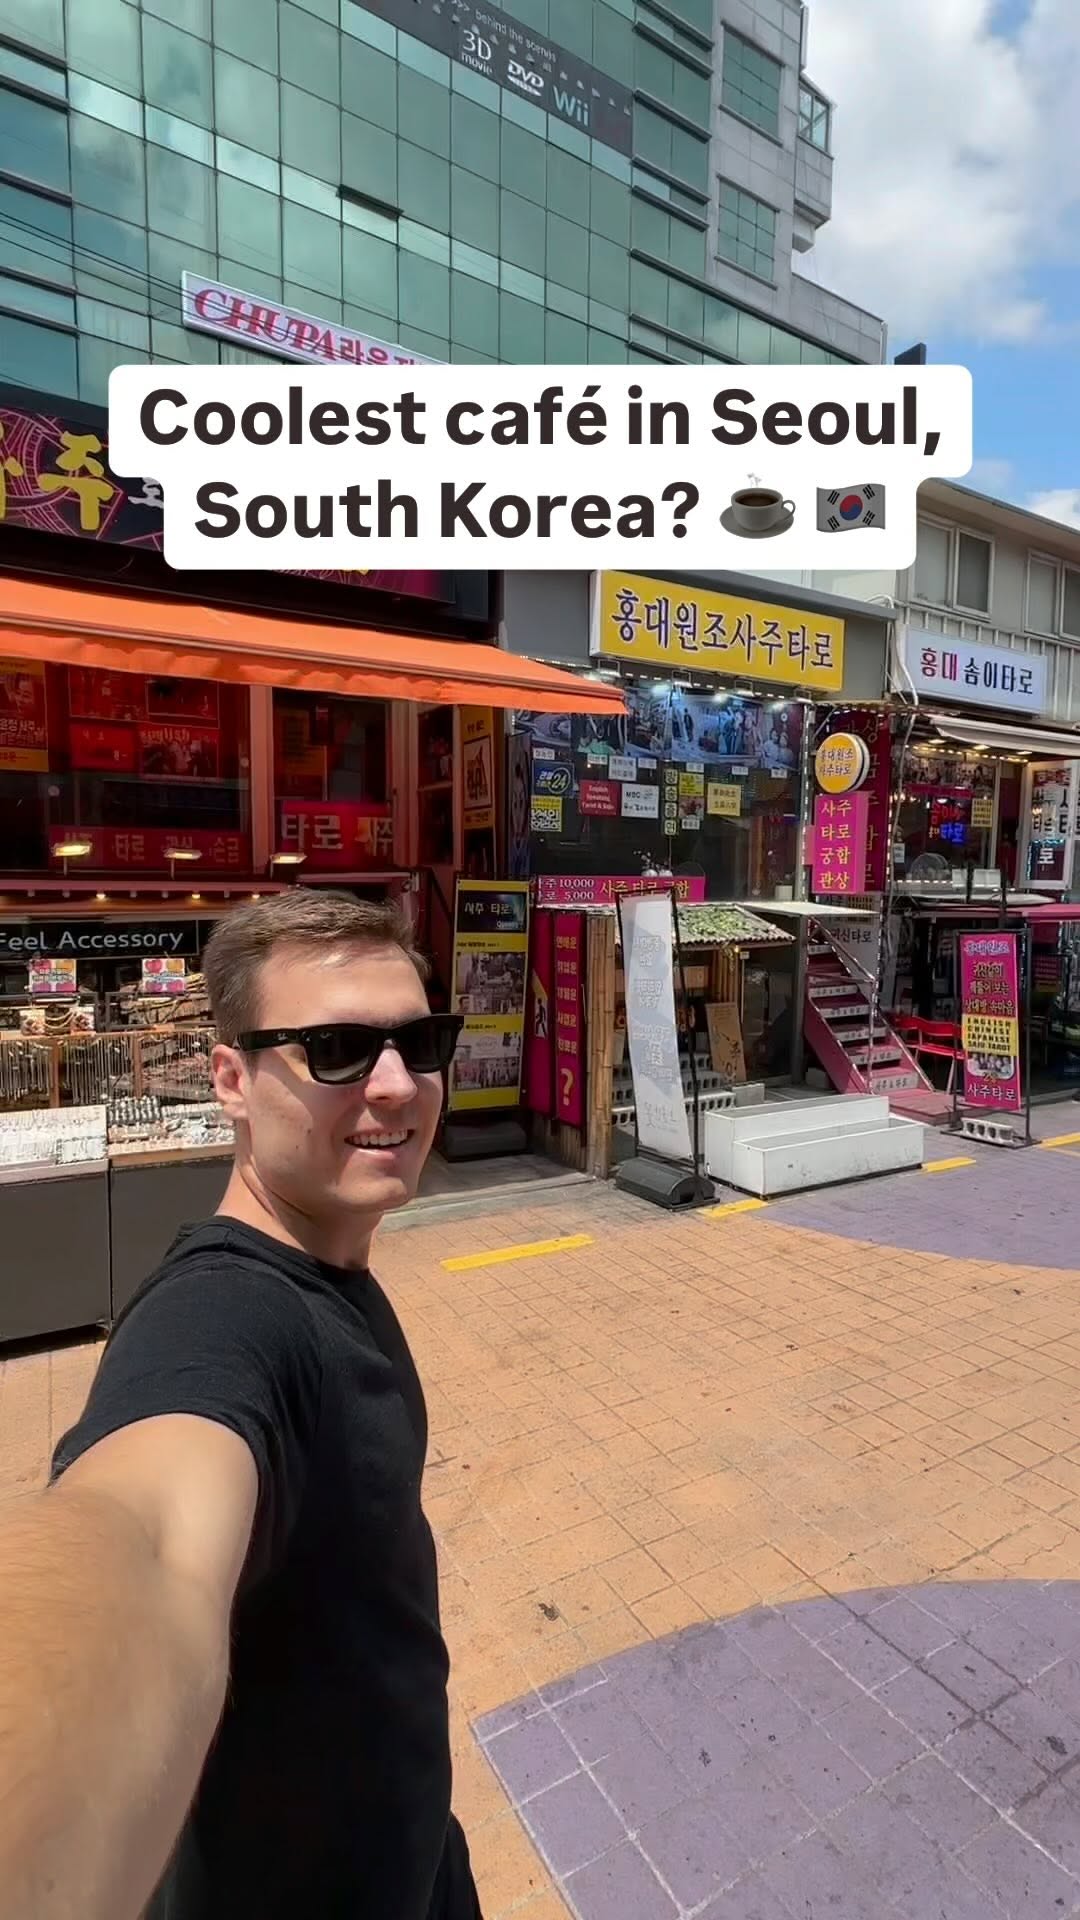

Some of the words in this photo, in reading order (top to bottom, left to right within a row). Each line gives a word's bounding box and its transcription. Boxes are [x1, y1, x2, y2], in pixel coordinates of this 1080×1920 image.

[475, 9, 507, 35] behind
[509, 27, 524, 45] the
[462, 29, 492, 61] 3D
[461, 51, 493, 76] movie
[507, 59, 545, 88] DVD
[552, 84, 589, 127] Wii
[194, 288, 337, 361] CHUPA
[611, 587, 834, 672] 홍대원조사주타로
[920, 647, 958, 681] 홍대
[964, 657, 1033, 695] 솜이타로
[551, 773, 568, 790] 24
[820, 800, 852, 818] 사주
[281, 813, 344, 851] 타로
[820, 824, 852, 841] 타로
[819, 847, 851, 865] 궁합
[559, 879, 594, 889] 10,000
[818, 871, 850, 889] 관상
[565, 891, 594, 901] 5,000
[58, 931, 184, 950] Accessory
[967, 1017, 1011, 1027] ENGLISH
[967, 1025, 1010, 1035] CHINESE
[967, 1033, 1010, 1043] JAPANESE
[968, 1083, 1016, 1101] 사주타로
